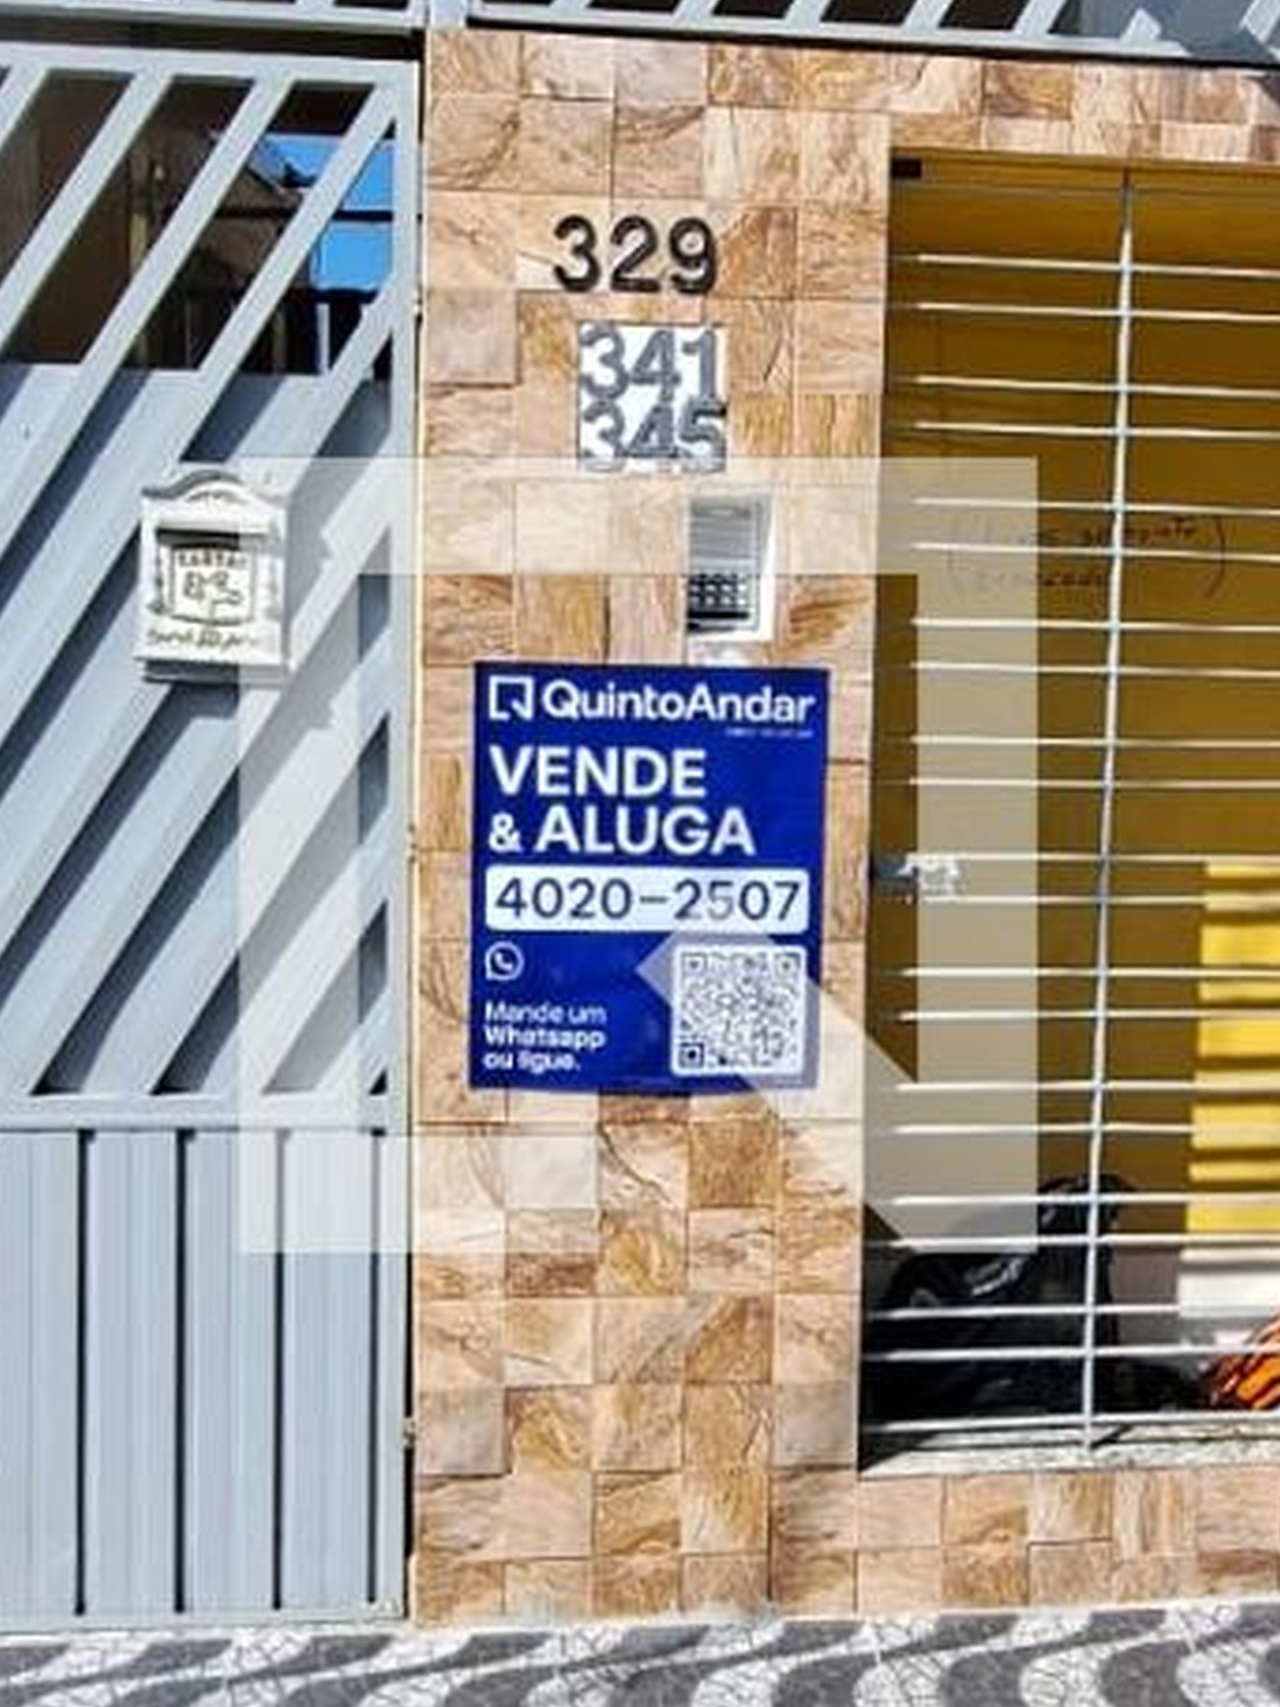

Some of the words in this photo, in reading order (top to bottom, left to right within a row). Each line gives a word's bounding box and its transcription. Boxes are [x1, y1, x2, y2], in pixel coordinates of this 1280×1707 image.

[552, 214, 718, 295] 329
[577, 322, 717, 402] 341
[580, 396, 728, 473] 345
[542, 679, 817, 723] QuintoAndar
[489, 745, 708, 799] VENDE
[487, 812, 522, 853] &
[533, 805, 757, 856] ALUGA
[494, 875, 801, 922] 4020-2507
[484, 1000, 564, 1024] Mande
[567, 1005, 607, 1025] um
[482, 1052, 514, 1070] ou
